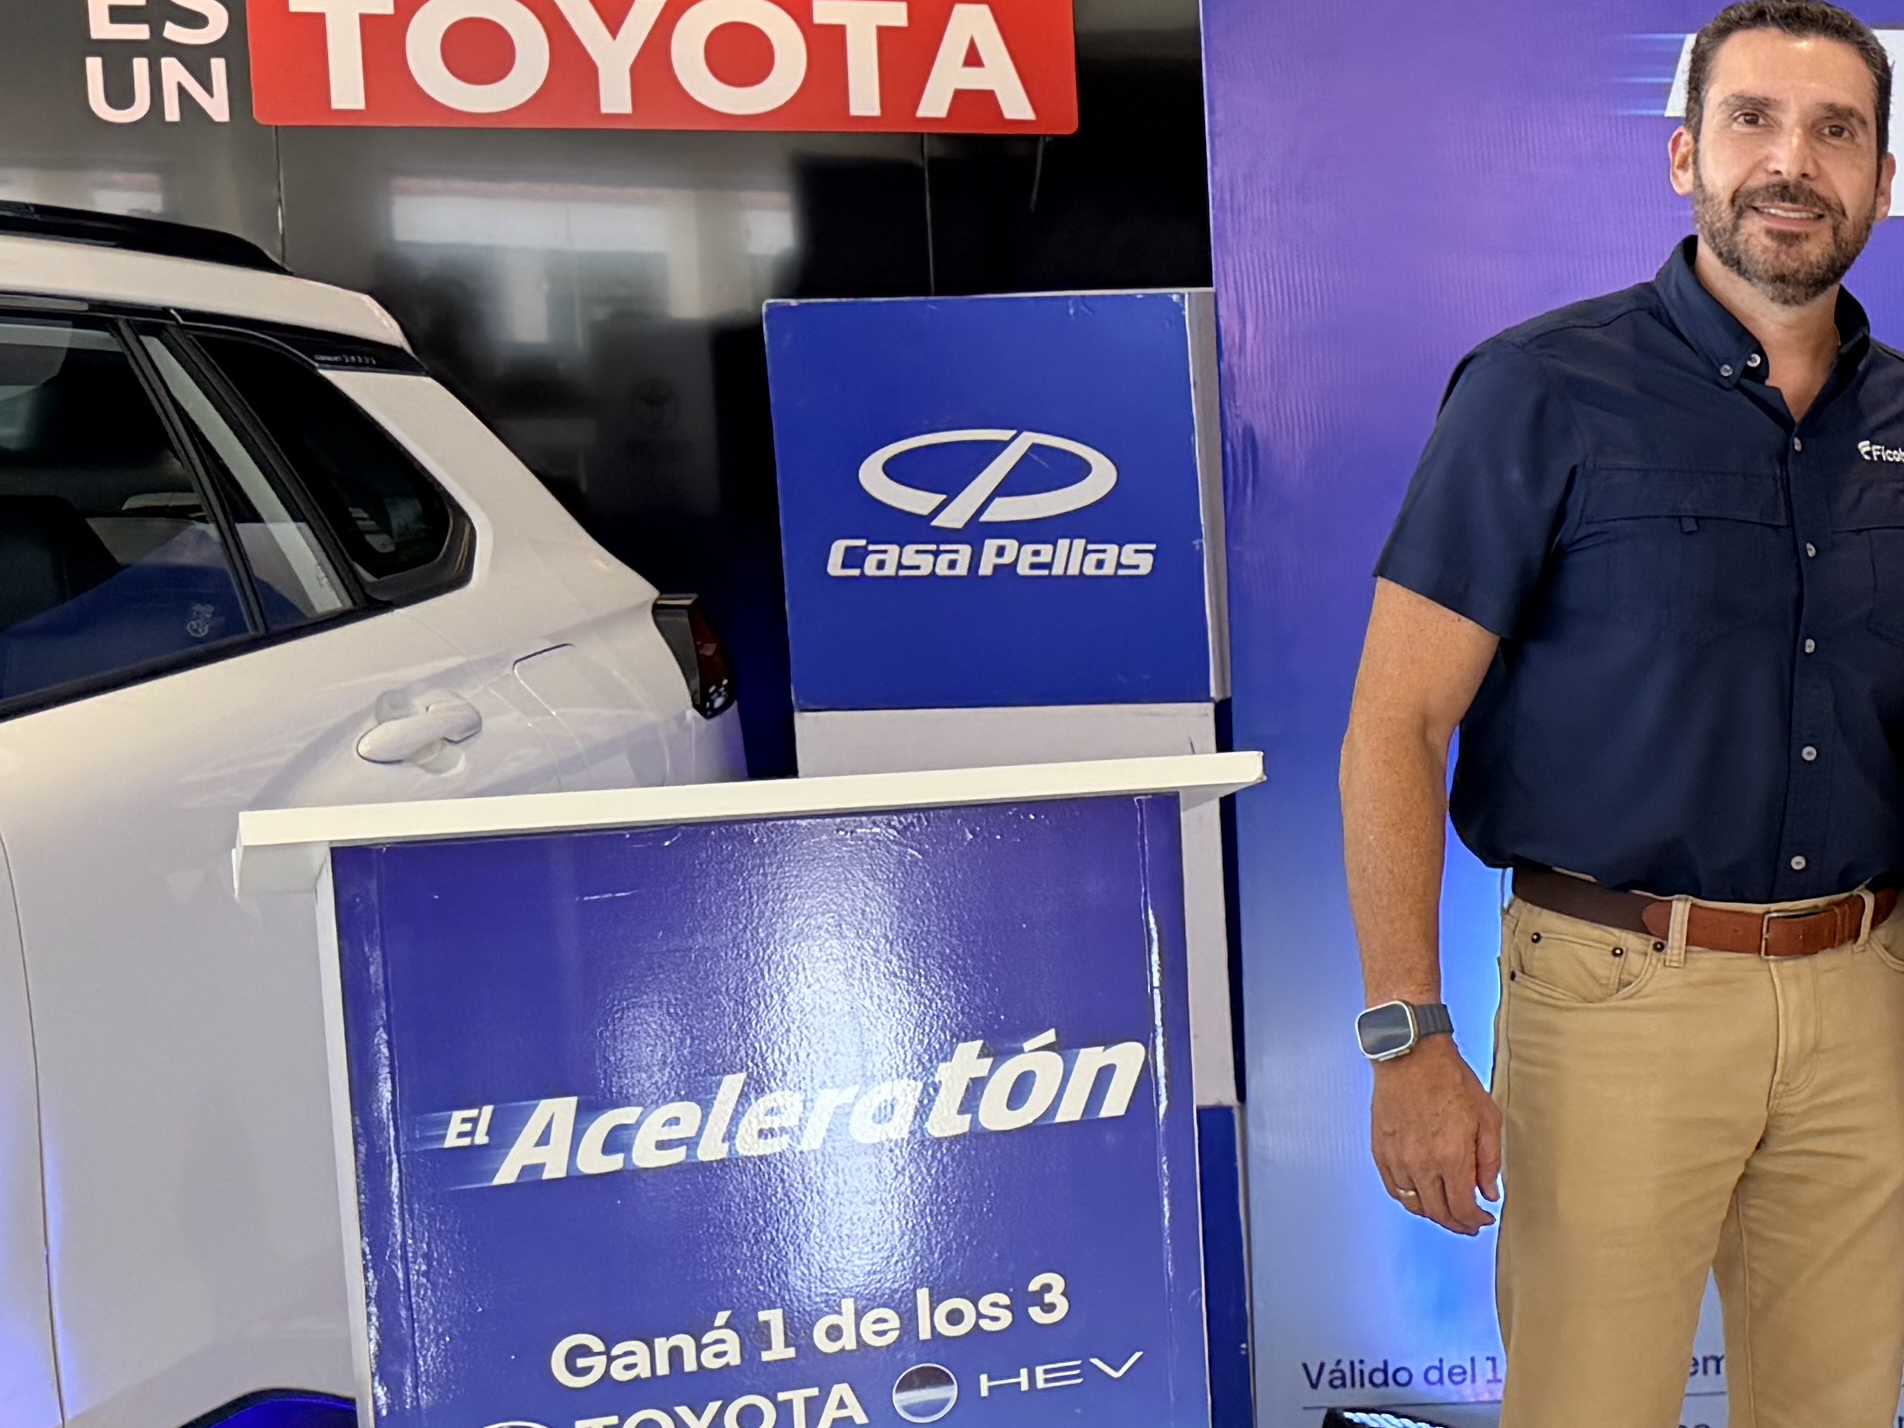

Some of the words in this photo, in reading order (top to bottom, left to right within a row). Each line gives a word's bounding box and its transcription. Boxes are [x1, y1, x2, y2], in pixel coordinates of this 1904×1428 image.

[85, 56, 230, 124] UN
[827, 538, 974, 577] Casa
[978, 538, 1157, 577] Pellas
[443, 1105, 493, 1149] El
[492, 1029, 1148, 1187] Aceleratón
[550, 1306, 741, 1389] Ganá
[757, 1308, 798, 1362] 1
[813, 1297, 901, 1356] de
[917, 1286, 1012, 1341] los
[1027, 1273, 1070, 1325] 3
[979, 1351, 1145, 1398] HEV
[1302, 1359, 1414, 1390] Válido
[1423, 1356, 1477, 1386] del
